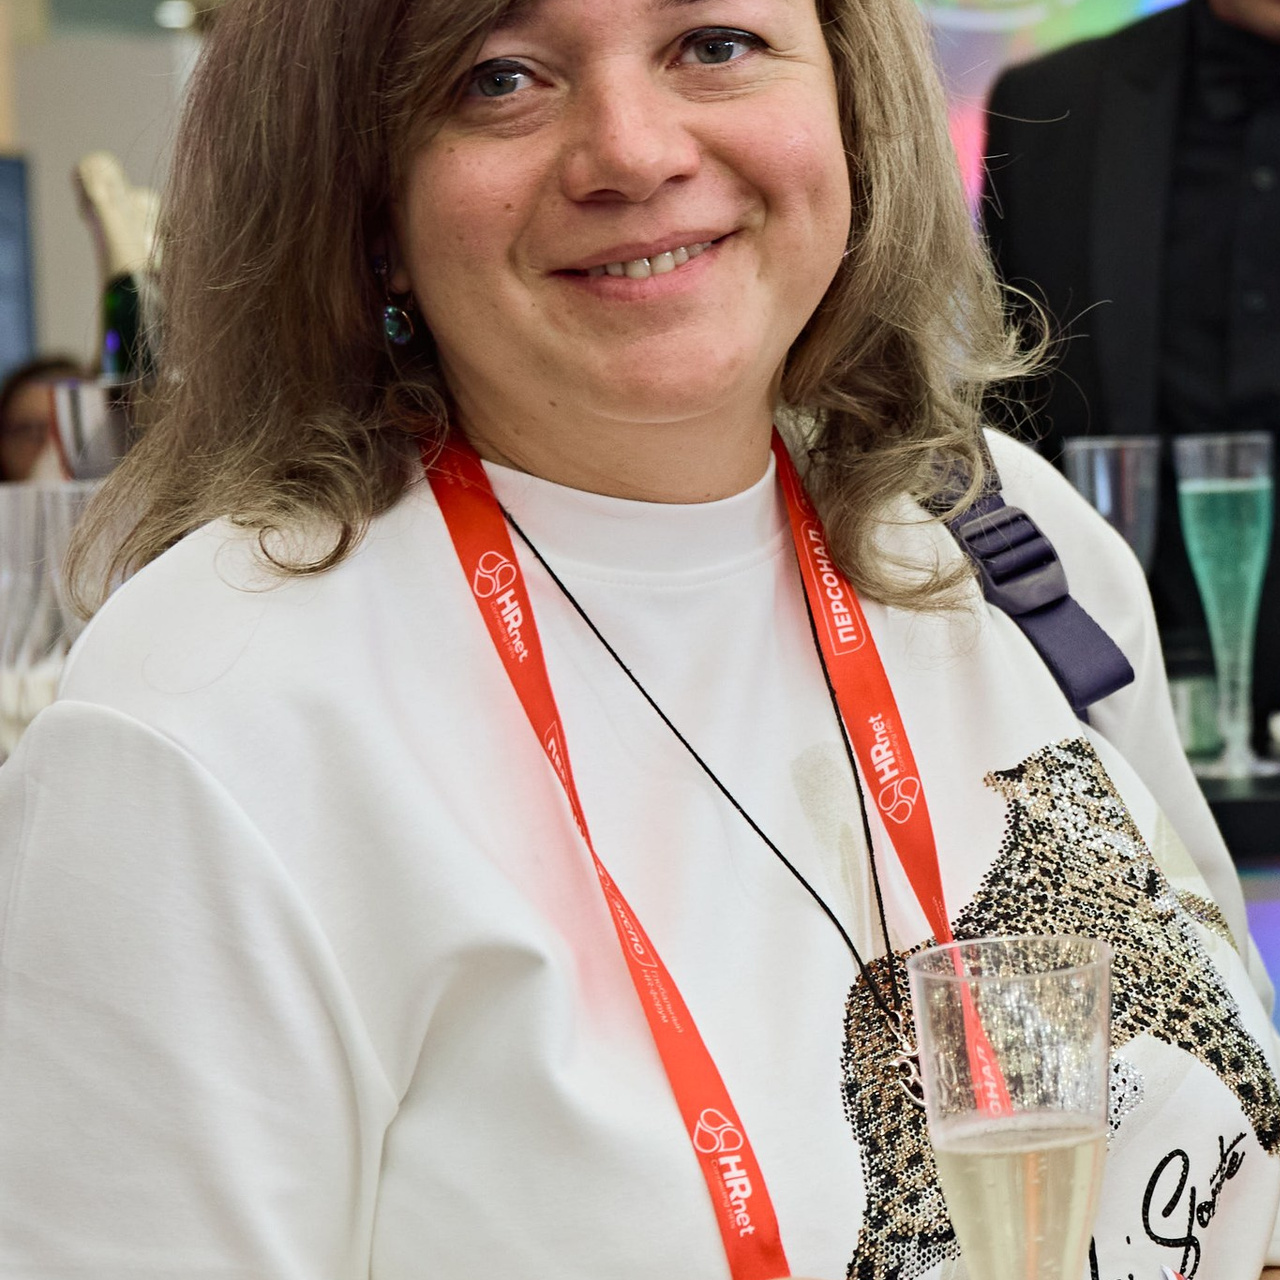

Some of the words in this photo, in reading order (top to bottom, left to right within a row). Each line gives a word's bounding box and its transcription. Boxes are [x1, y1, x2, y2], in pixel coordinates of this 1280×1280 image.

[811, 535, 854, 642] ПЕРСОНАЛ
[497, 590, 528, 663] HRnet
[870, 715, 899, 784] HRnet
[651, 971, 683, 1033] Глобальный
[720, 1156, 754, 1236] HRnet
